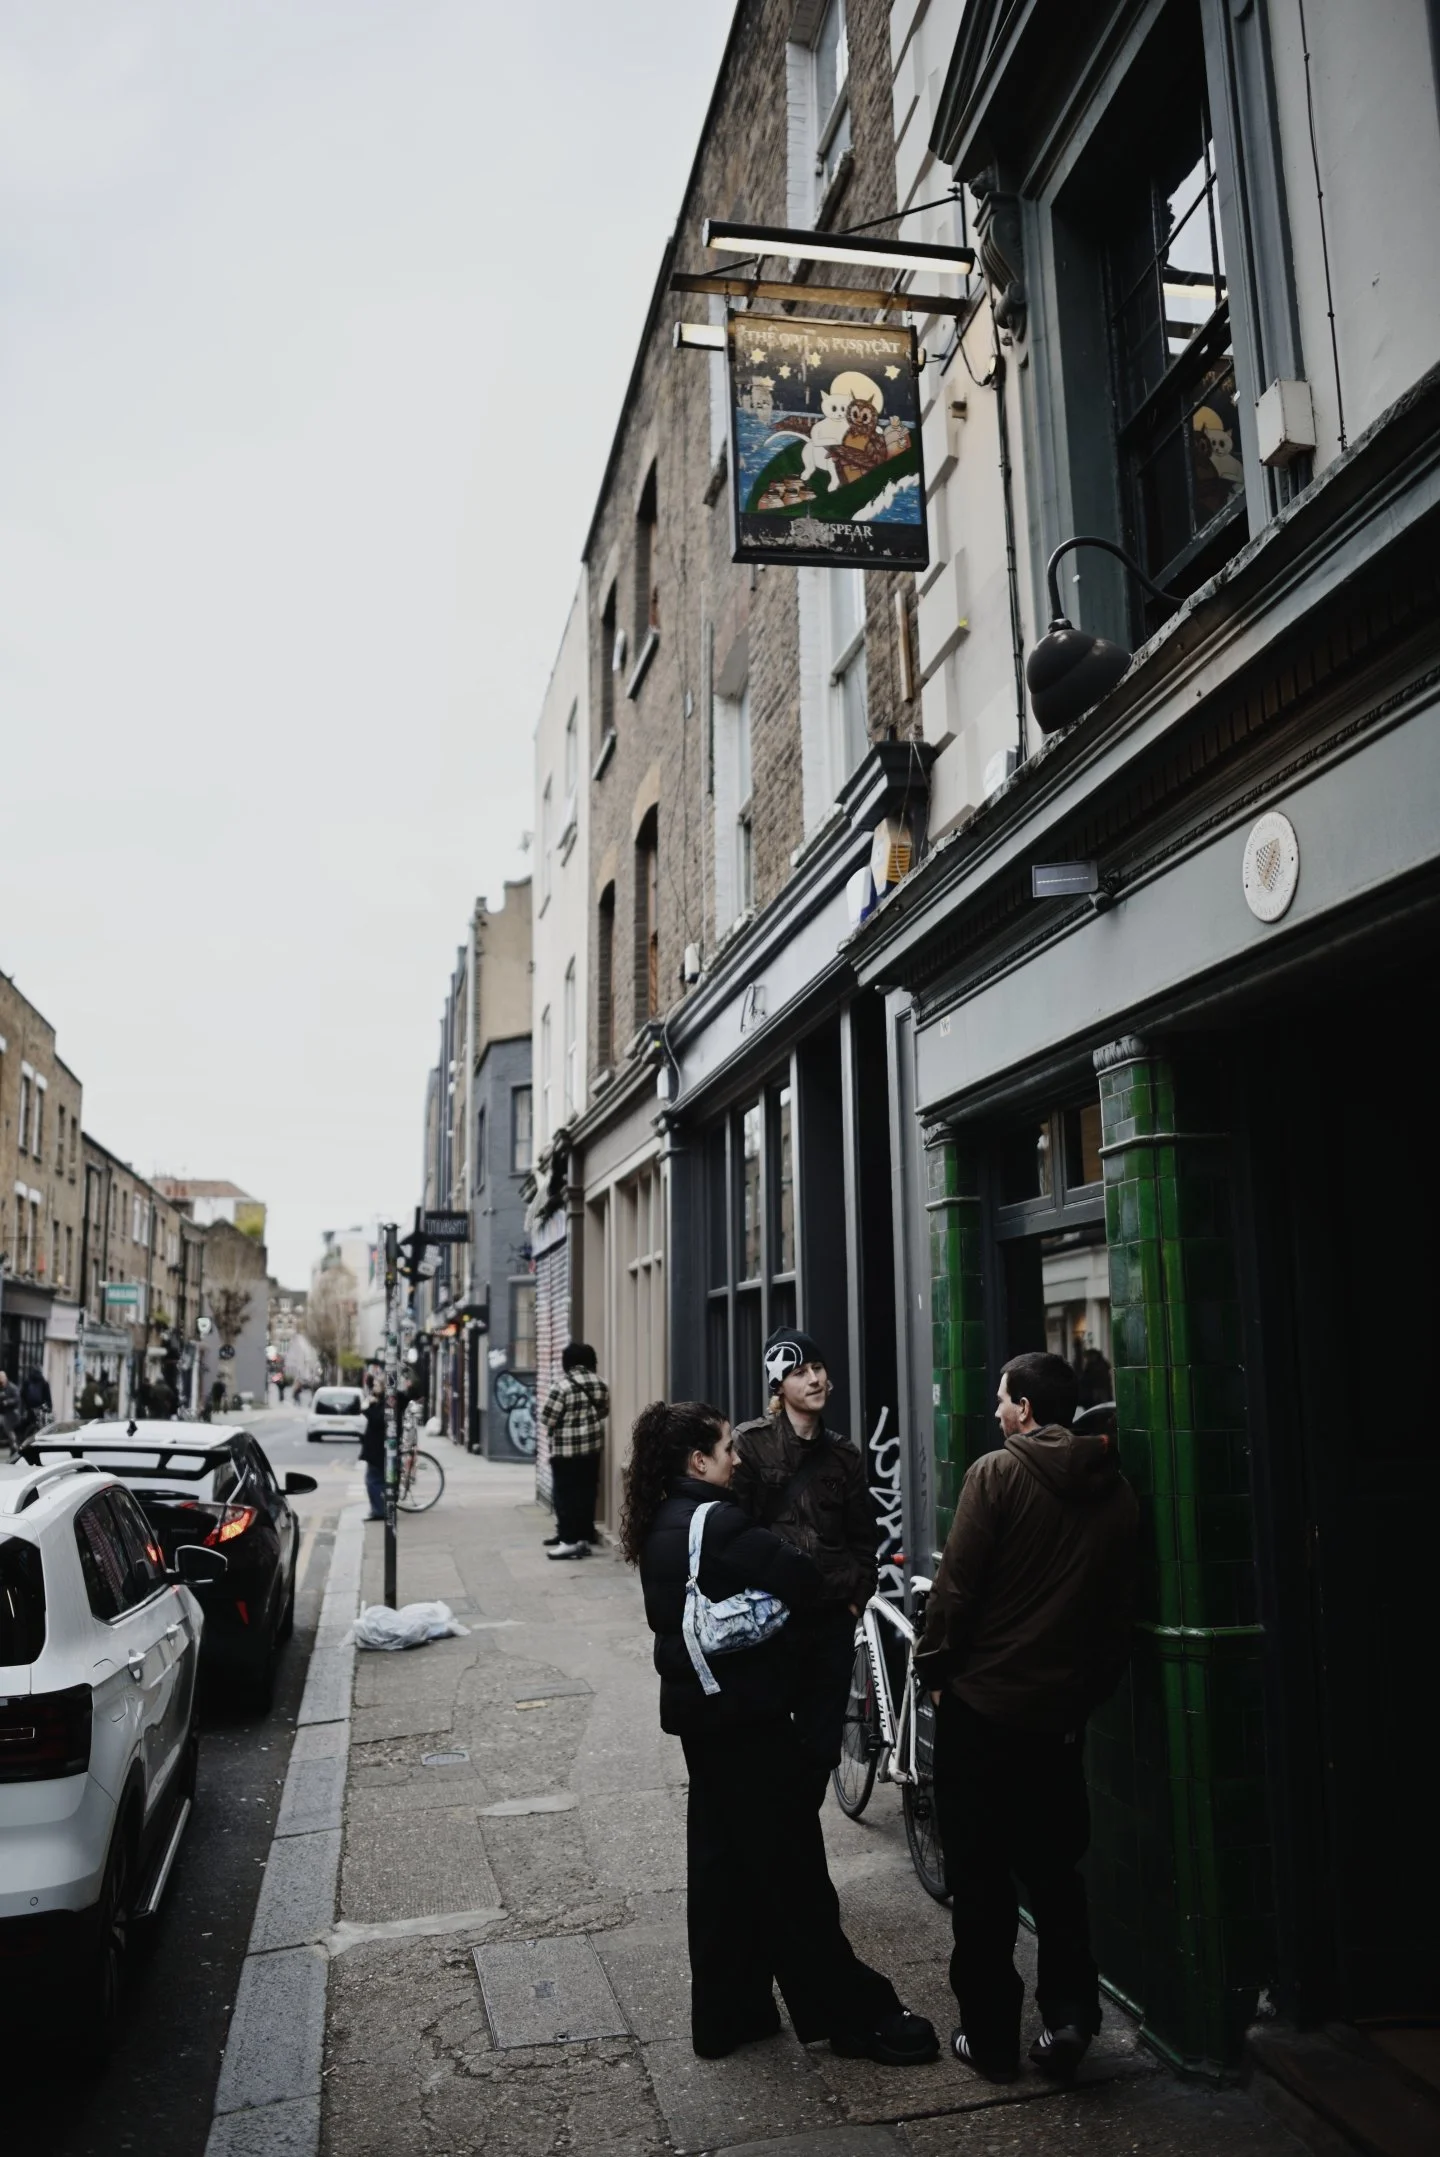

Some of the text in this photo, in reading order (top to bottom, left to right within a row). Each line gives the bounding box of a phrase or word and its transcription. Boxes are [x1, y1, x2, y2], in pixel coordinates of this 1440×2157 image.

[745, 330, 776, 346] THE
[832, 337, 900, 353] PUSSYCAT
[426, 1219, 467, 1234] TOAST
